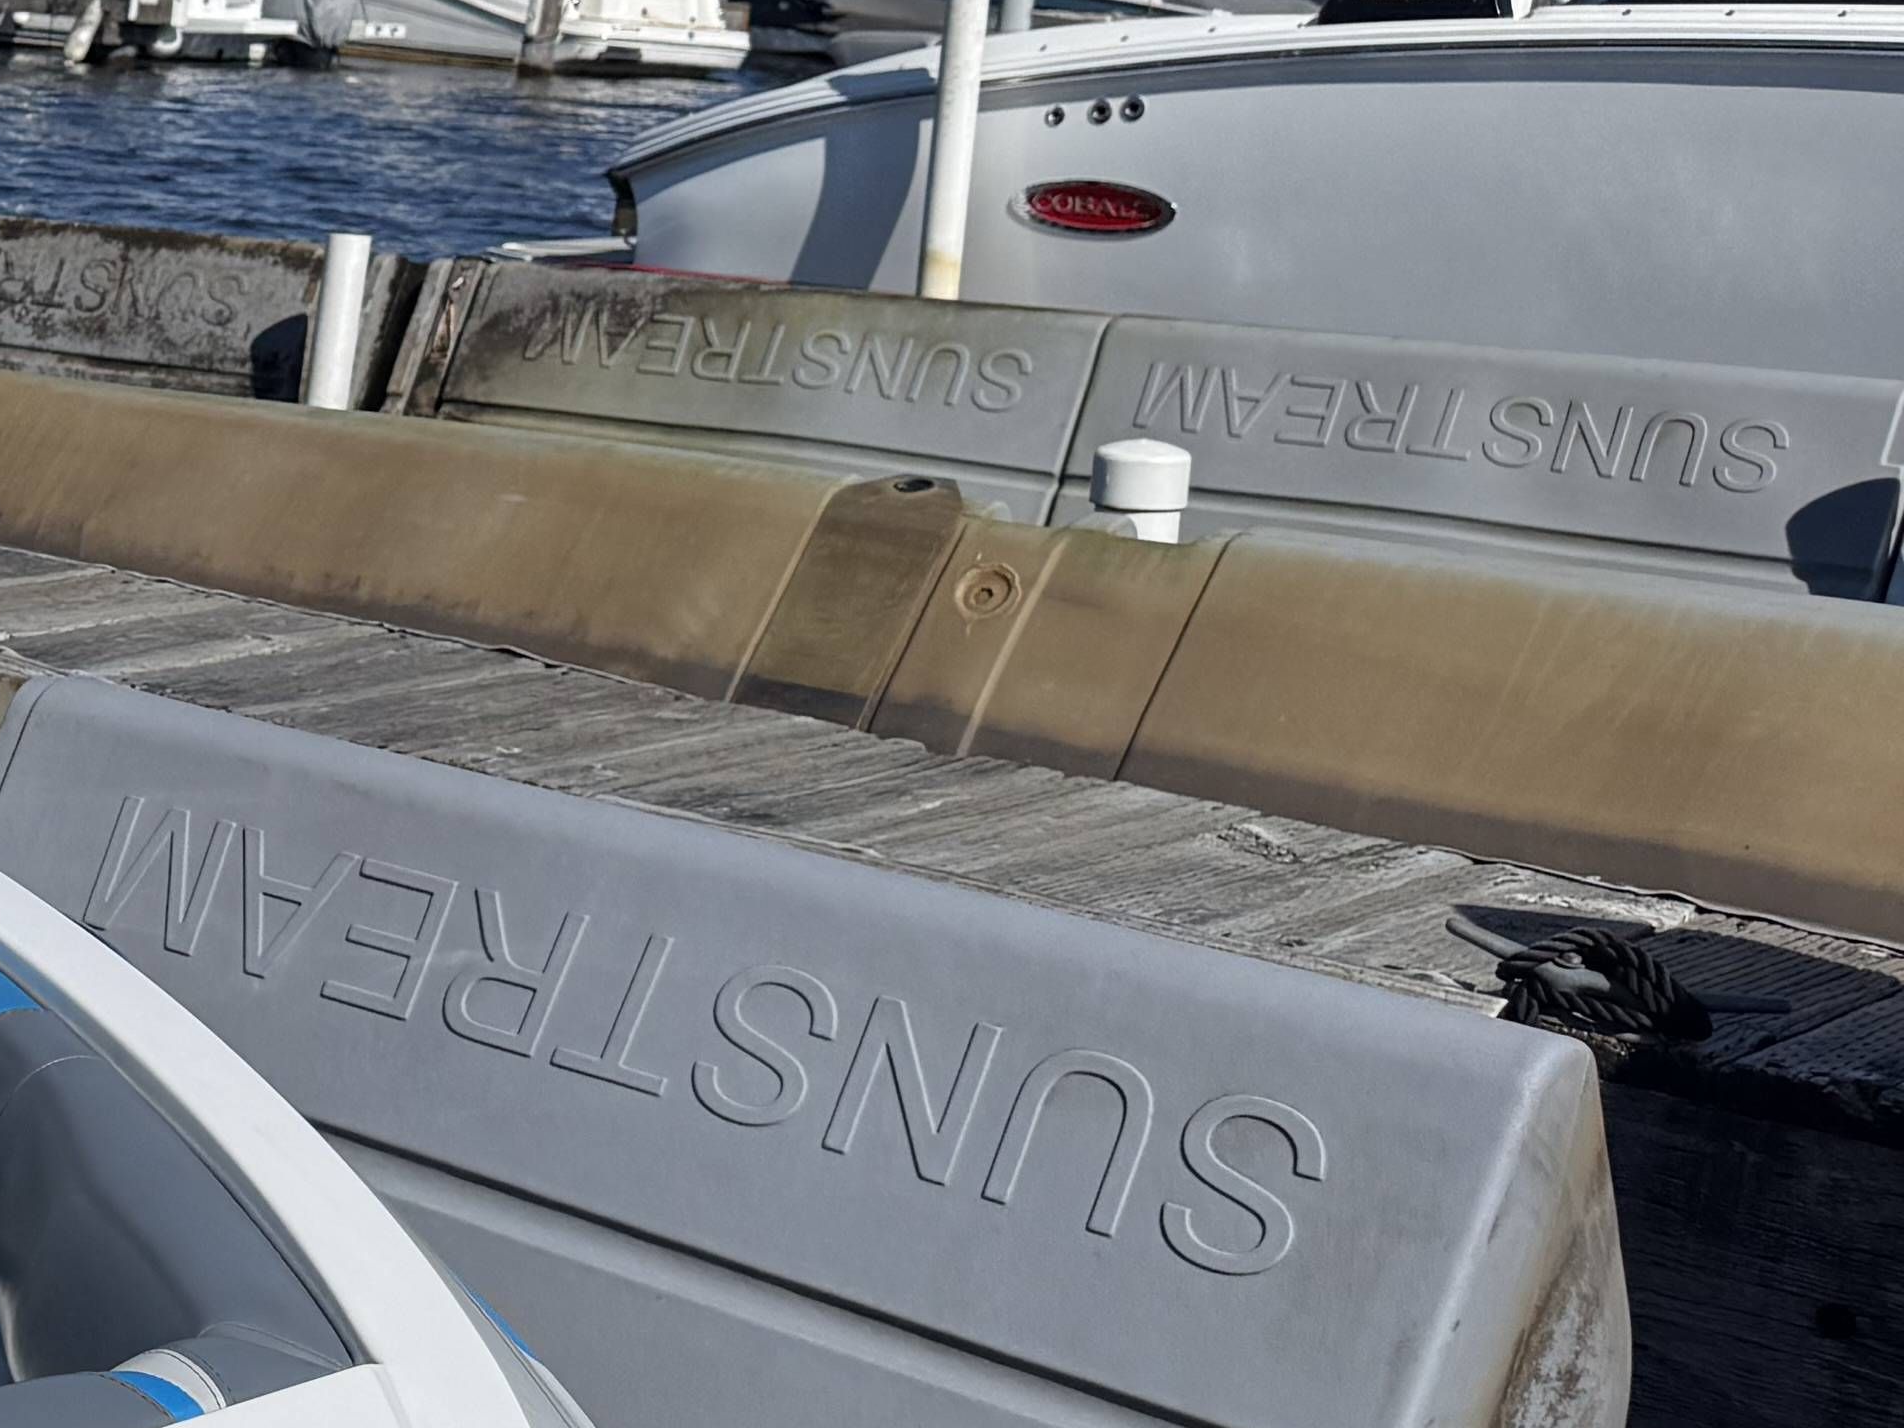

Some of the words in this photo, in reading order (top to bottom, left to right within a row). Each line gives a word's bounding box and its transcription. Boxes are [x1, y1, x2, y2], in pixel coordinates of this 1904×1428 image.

[522, 298, 1034, 413] SUNSTREAM
[1130, 361, 1792, 494] SUNSTREAM
[82, 794, 1327, 1278] SUNSTREAM
